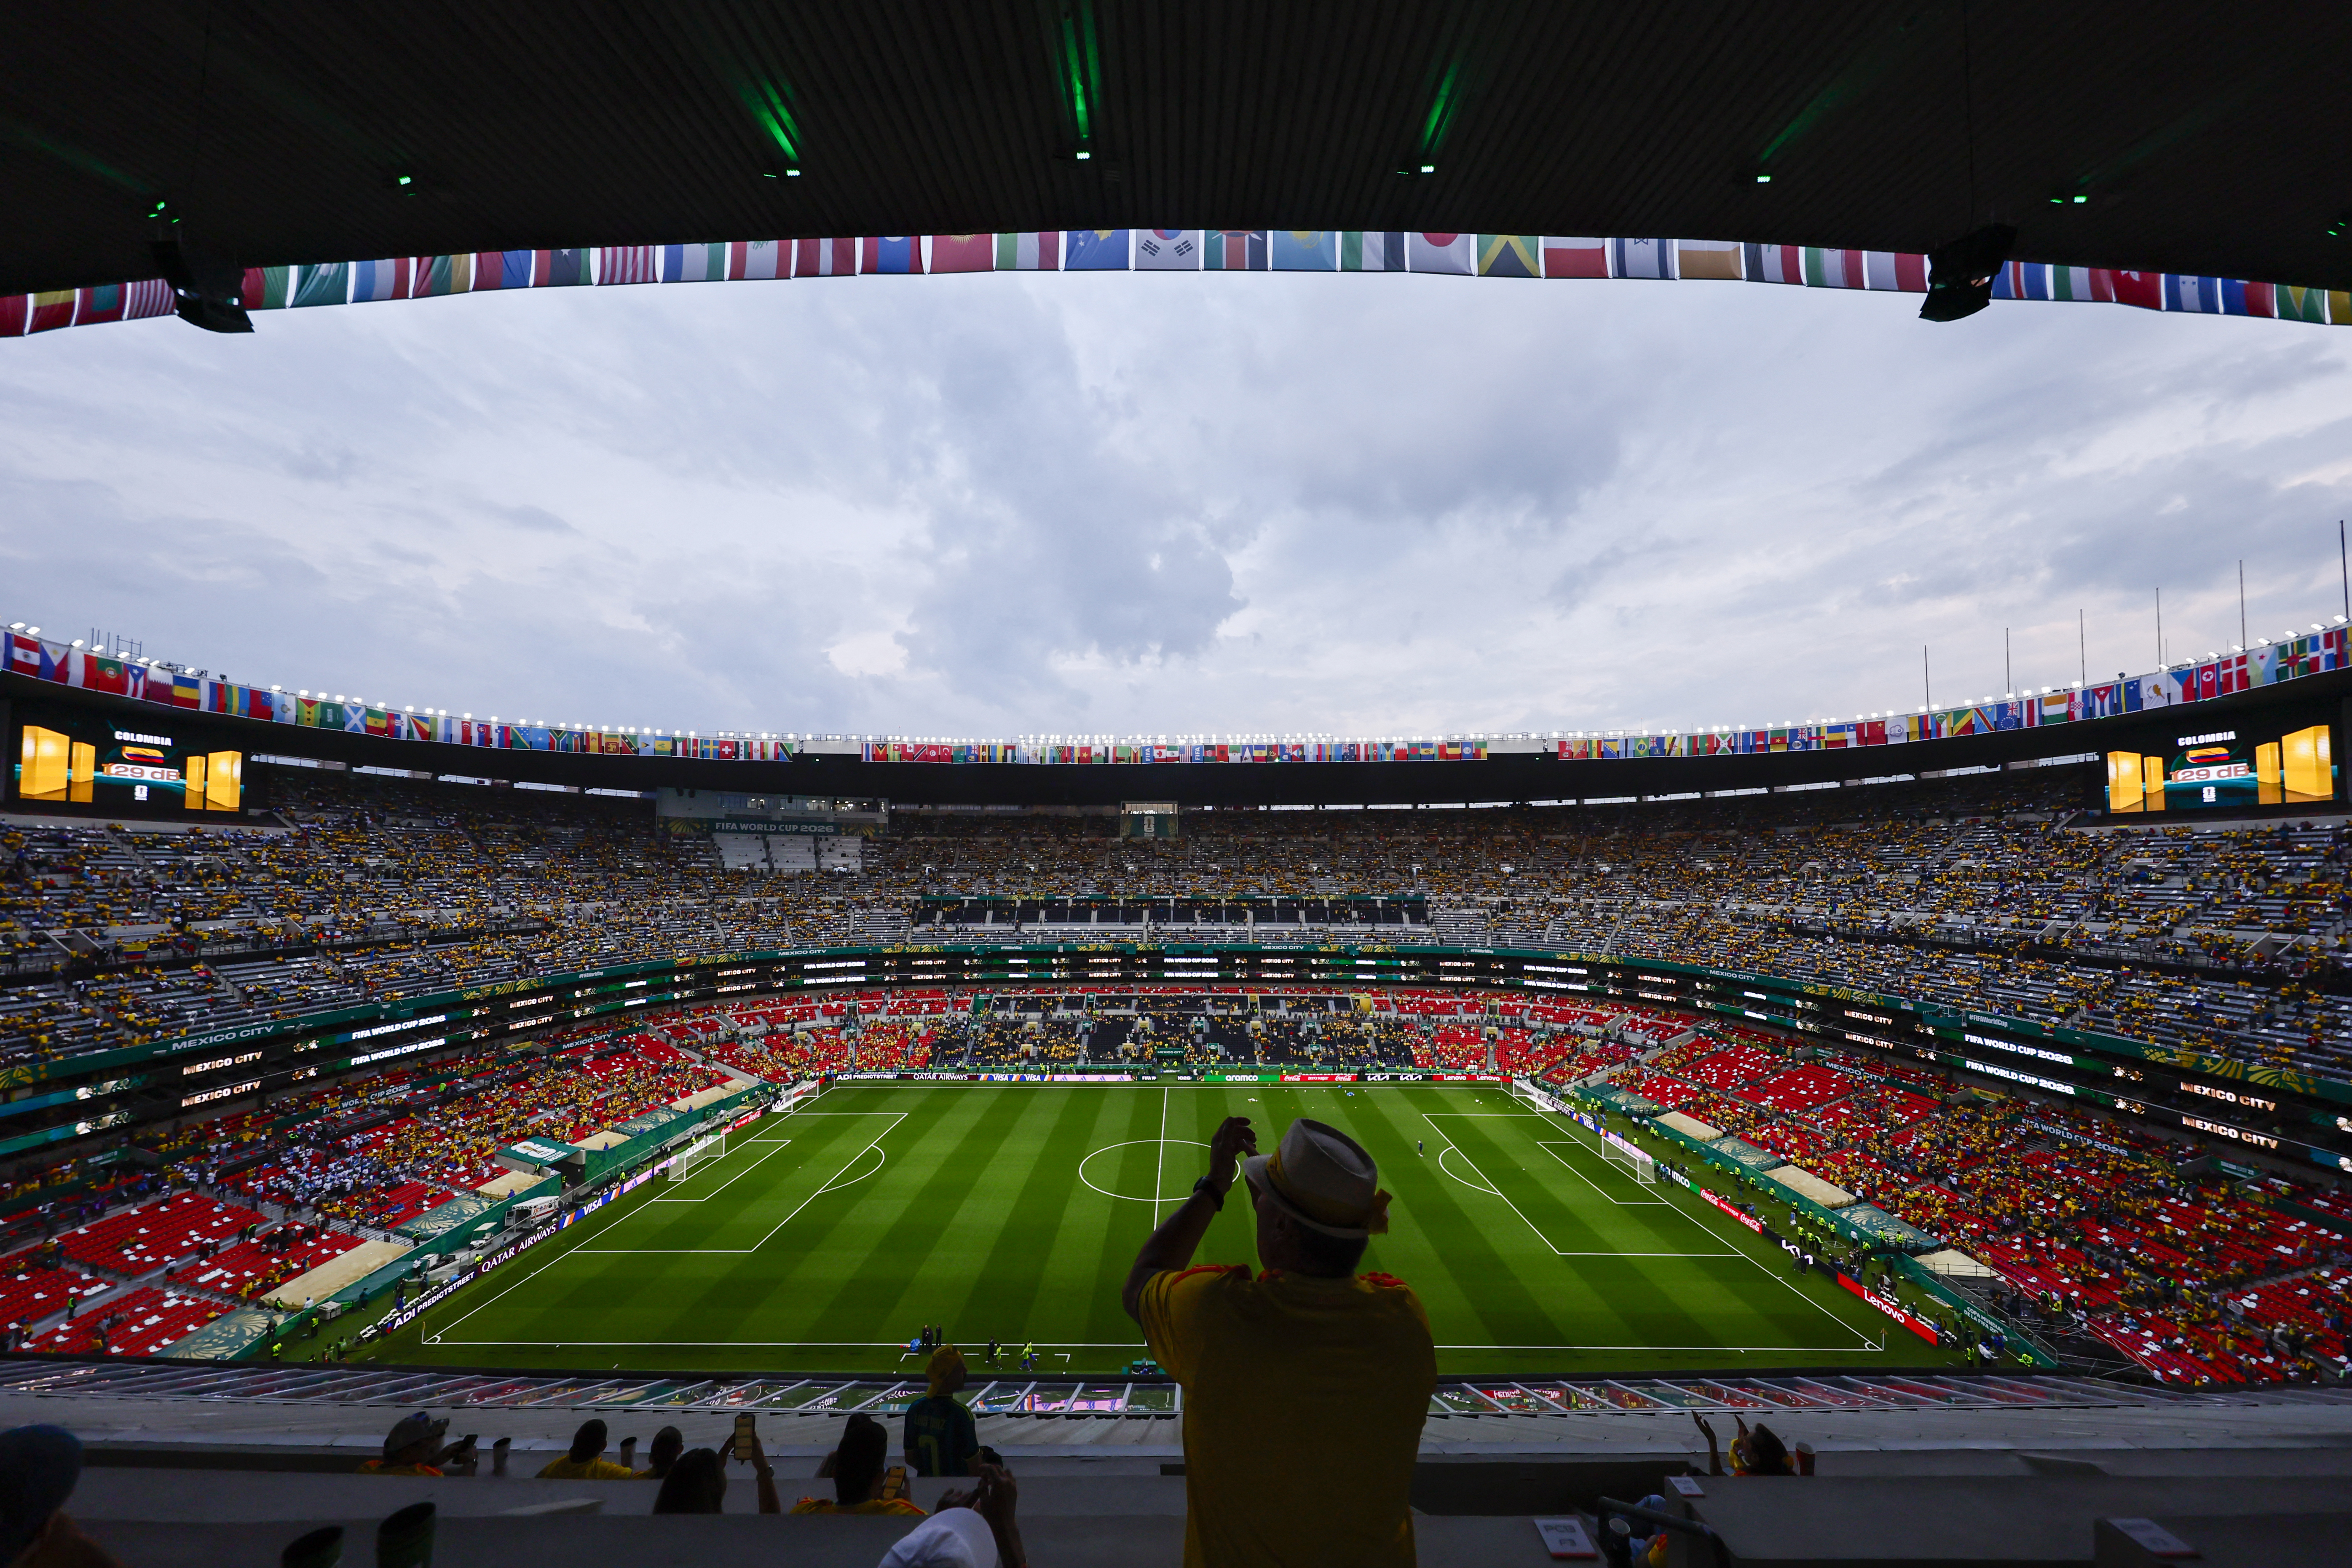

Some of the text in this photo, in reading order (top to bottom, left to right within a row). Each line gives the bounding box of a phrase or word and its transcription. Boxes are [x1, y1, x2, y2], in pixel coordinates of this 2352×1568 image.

[115, 731, 171, 746] COLOMBIA
[2178, 731, 2236, 746] COLOMBIA
[102, 763, 180, 781] 129 dB
[2171, 765, 2249, 782] 129 dB
[1710, 970, 1756, 981] MEXICO CITY
[510, 999, 536, 1008] MEXICO
[509, 1016, 552, 1029] MEXICO CITY
[1845, 1010, 1872, 1021] MEXICO
[1969, 1013, 2008, 1027] #FIFAWorldCup
[172, 1024, 274, 1050] MEXICO CITY
[352, 1015, 446, 1039] FIFA WORLD CUP 2026
[563, 1033, 612, 1049] MEXICO CITY
[1846, 1033, 1893, 1049] MEXICO CITY
[1965, 1035, 2073, 1064] FIFA WORLD CUP 2026
[351, 1039, 445, 1065] FIFA WORLD CUP 2026
[183, 1052, 262, 1075] MEXICO CITY
[1826, 1061, 1886, 1083] MEXICO CITY
[1966, 1060, 2075, 1094] FIFA WORLD CUP 2026
[182, 1081, 260, 1107] MEXICO CITY
[370, 1083, 410, 1101] CUP 2026
[803, 1083, 817, 1093] Lenovo
[2181, 1082, 2275, 1110] MEXICO CITY
[1540, 1095, 1570, 1116] QATAR AIRWAYS
[1583, 1118, 1595, 1131] VISA
[2183, 1116, 2279, 1148] MEXICO CITY
[2041, 1123, 2073, 1140] WORLD
[2093, 1139, 2128, 1157] 2026
[583, 1198, 603, 1215] VISA
[1720, 1202, 1728, 1210] zero
[1729, 1208, 1739, 1217] sugar
[481, 1223, 556, 1273] QATAR AIRWAYS
[394, 1271, 475, 1330] ADI PREDICTSTREET
[1864, 1289, 1905, 1323] Lenovo
[1964, 1309, 1970, 1317] DE
[1978, 1319, 1989, 1329] FIFA
[1967, 1307, 2004, 1334] COPA MUNDIAL
